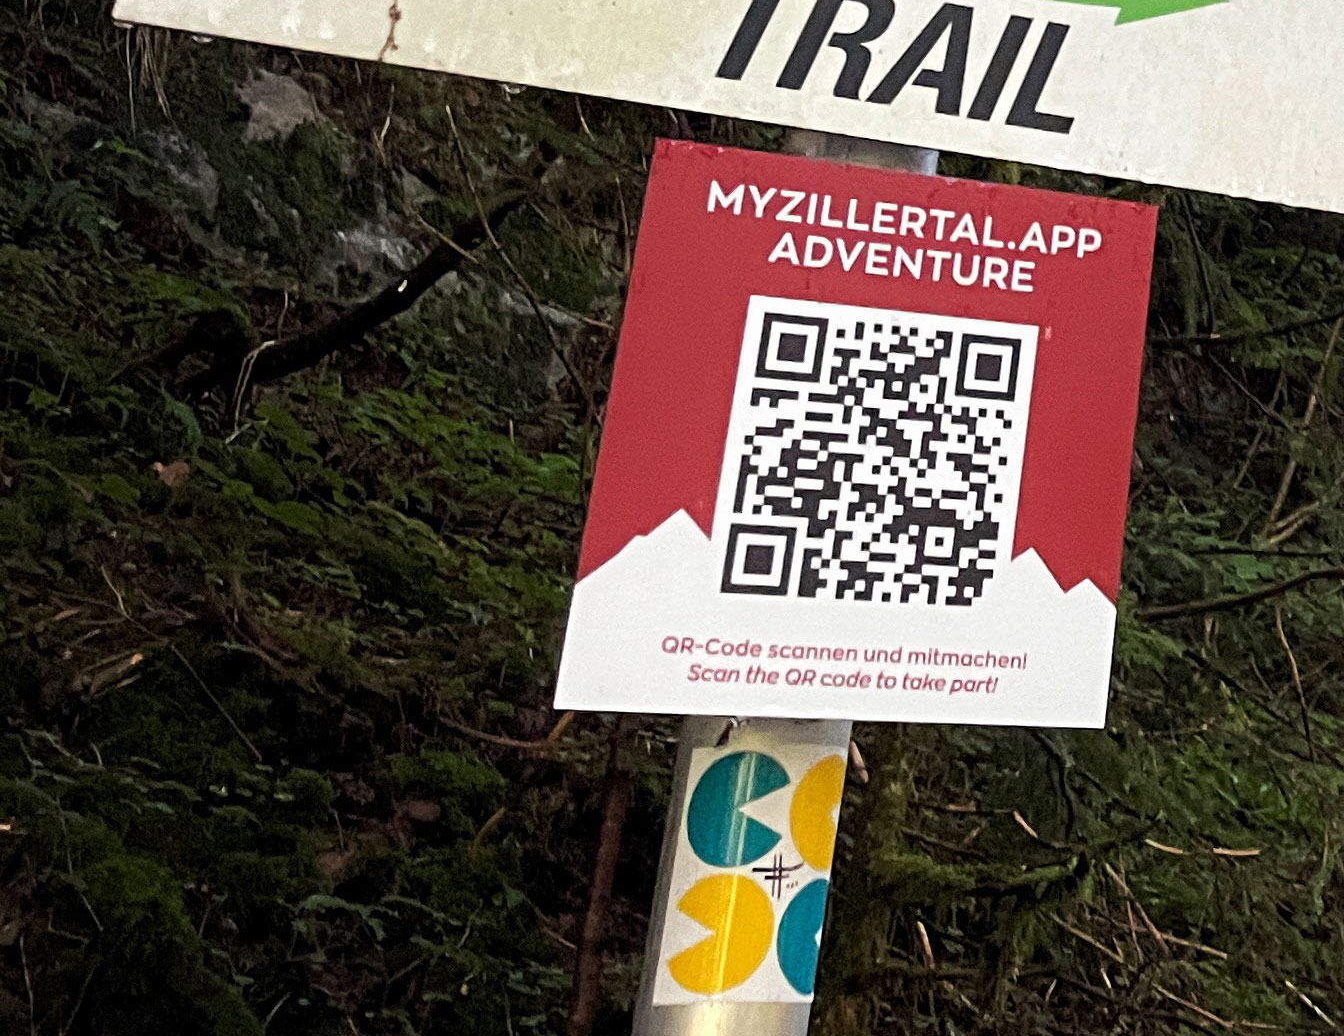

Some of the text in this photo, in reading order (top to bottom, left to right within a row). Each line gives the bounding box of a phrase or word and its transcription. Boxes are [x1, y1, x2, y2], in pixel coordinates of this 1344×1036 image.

[706, 180, 1103, 260] MYZILLERTAL.APP
[767, 233, 1036, 293] ADVENTURE
[661, 635, 1027, 670] QR-Code scannen und mitmachen!
[687, 663, 999, 696] Scan the QR code to take part!
